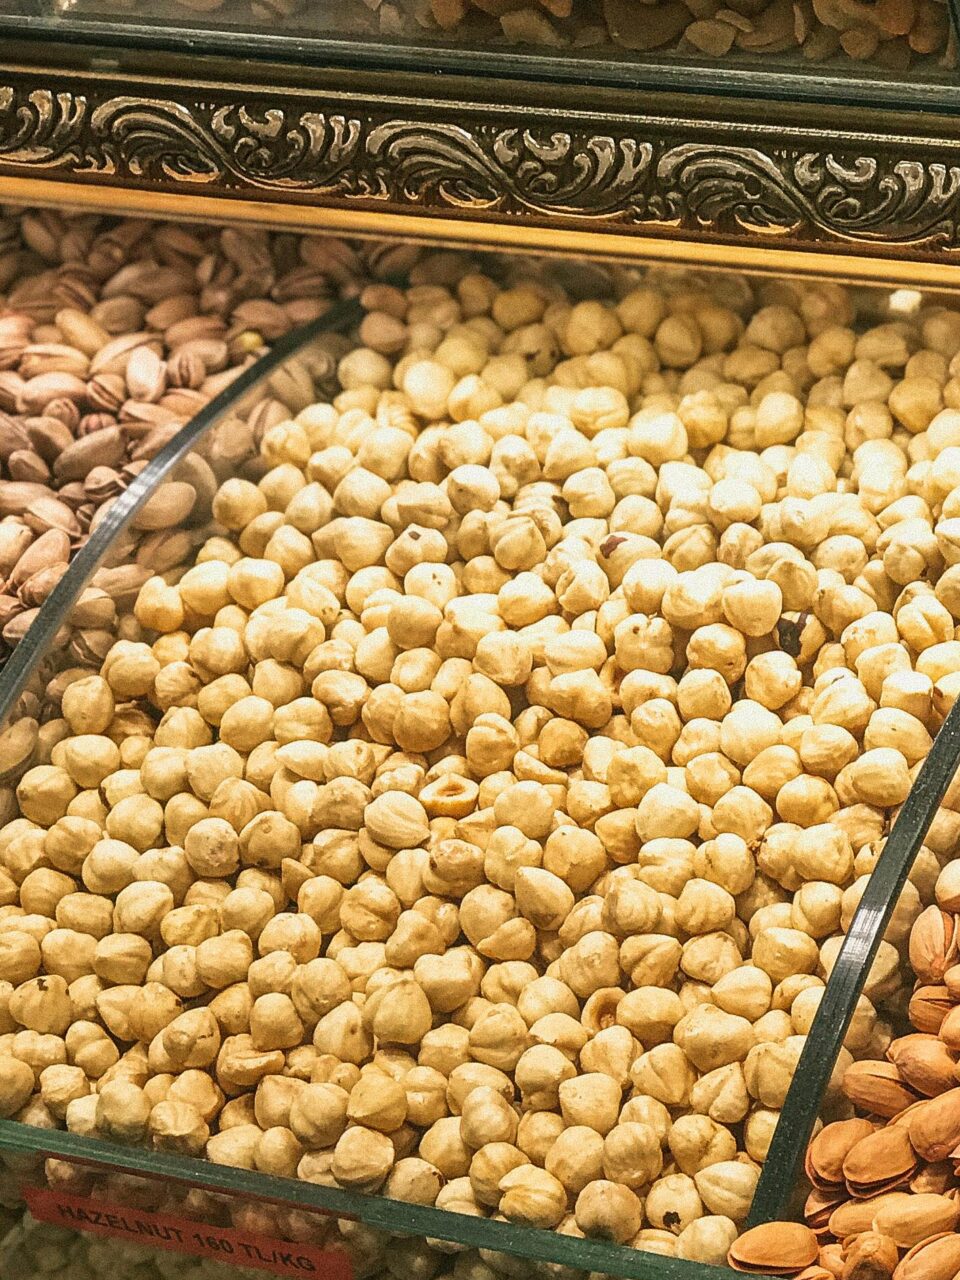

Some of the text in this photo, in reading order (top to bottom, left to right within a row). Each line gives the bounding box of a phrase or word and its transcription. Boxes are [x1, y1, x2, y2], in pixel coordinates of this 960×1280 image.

[58, 1204, 317, 1272] HAZELNUT 160 TL/KG
